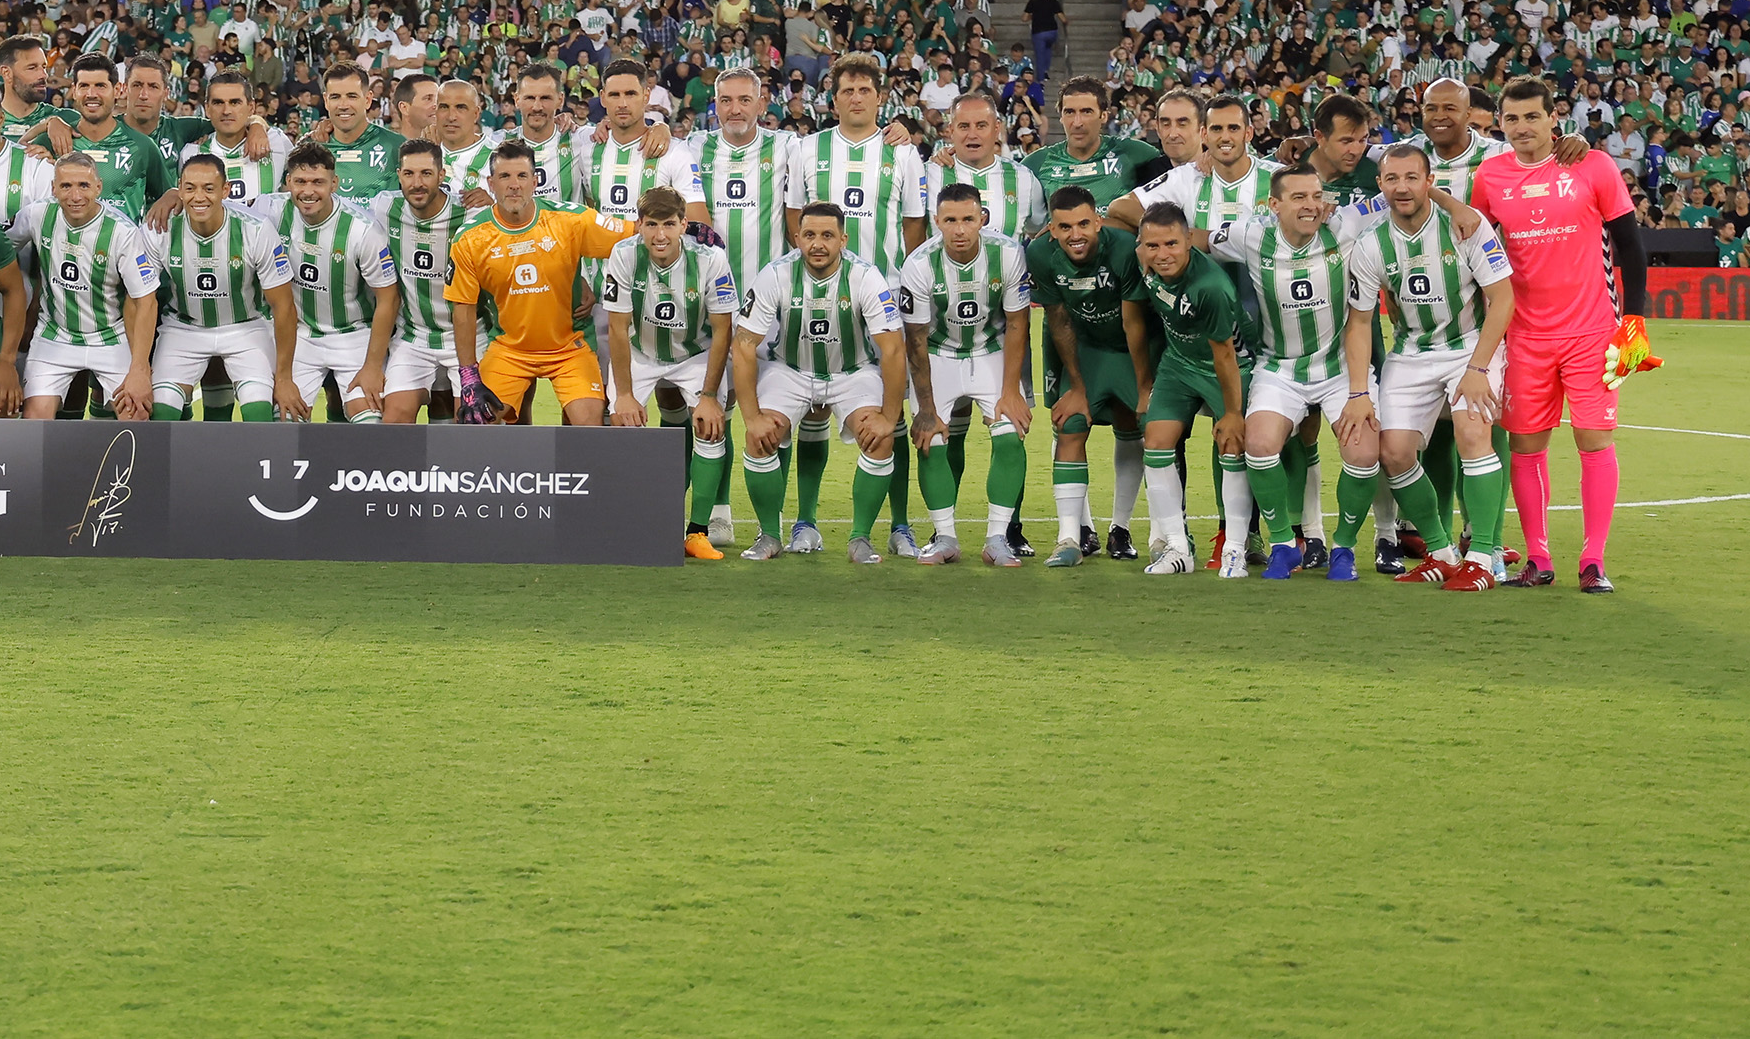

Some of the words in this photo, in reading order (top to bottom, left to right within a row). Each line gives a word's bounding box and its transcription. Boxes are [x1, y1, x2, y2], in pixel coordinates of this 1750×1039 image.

[716, 199, 757, 209] finetwork
[403, 268, 443, 279] finetwork
[292, 277, 328, 292] inetwork
[188, 290, 229, 299] finetwork
[1281, 298, 1326, 309] finetwork
[366, 502, 552, 520] FUNDACIÓN
